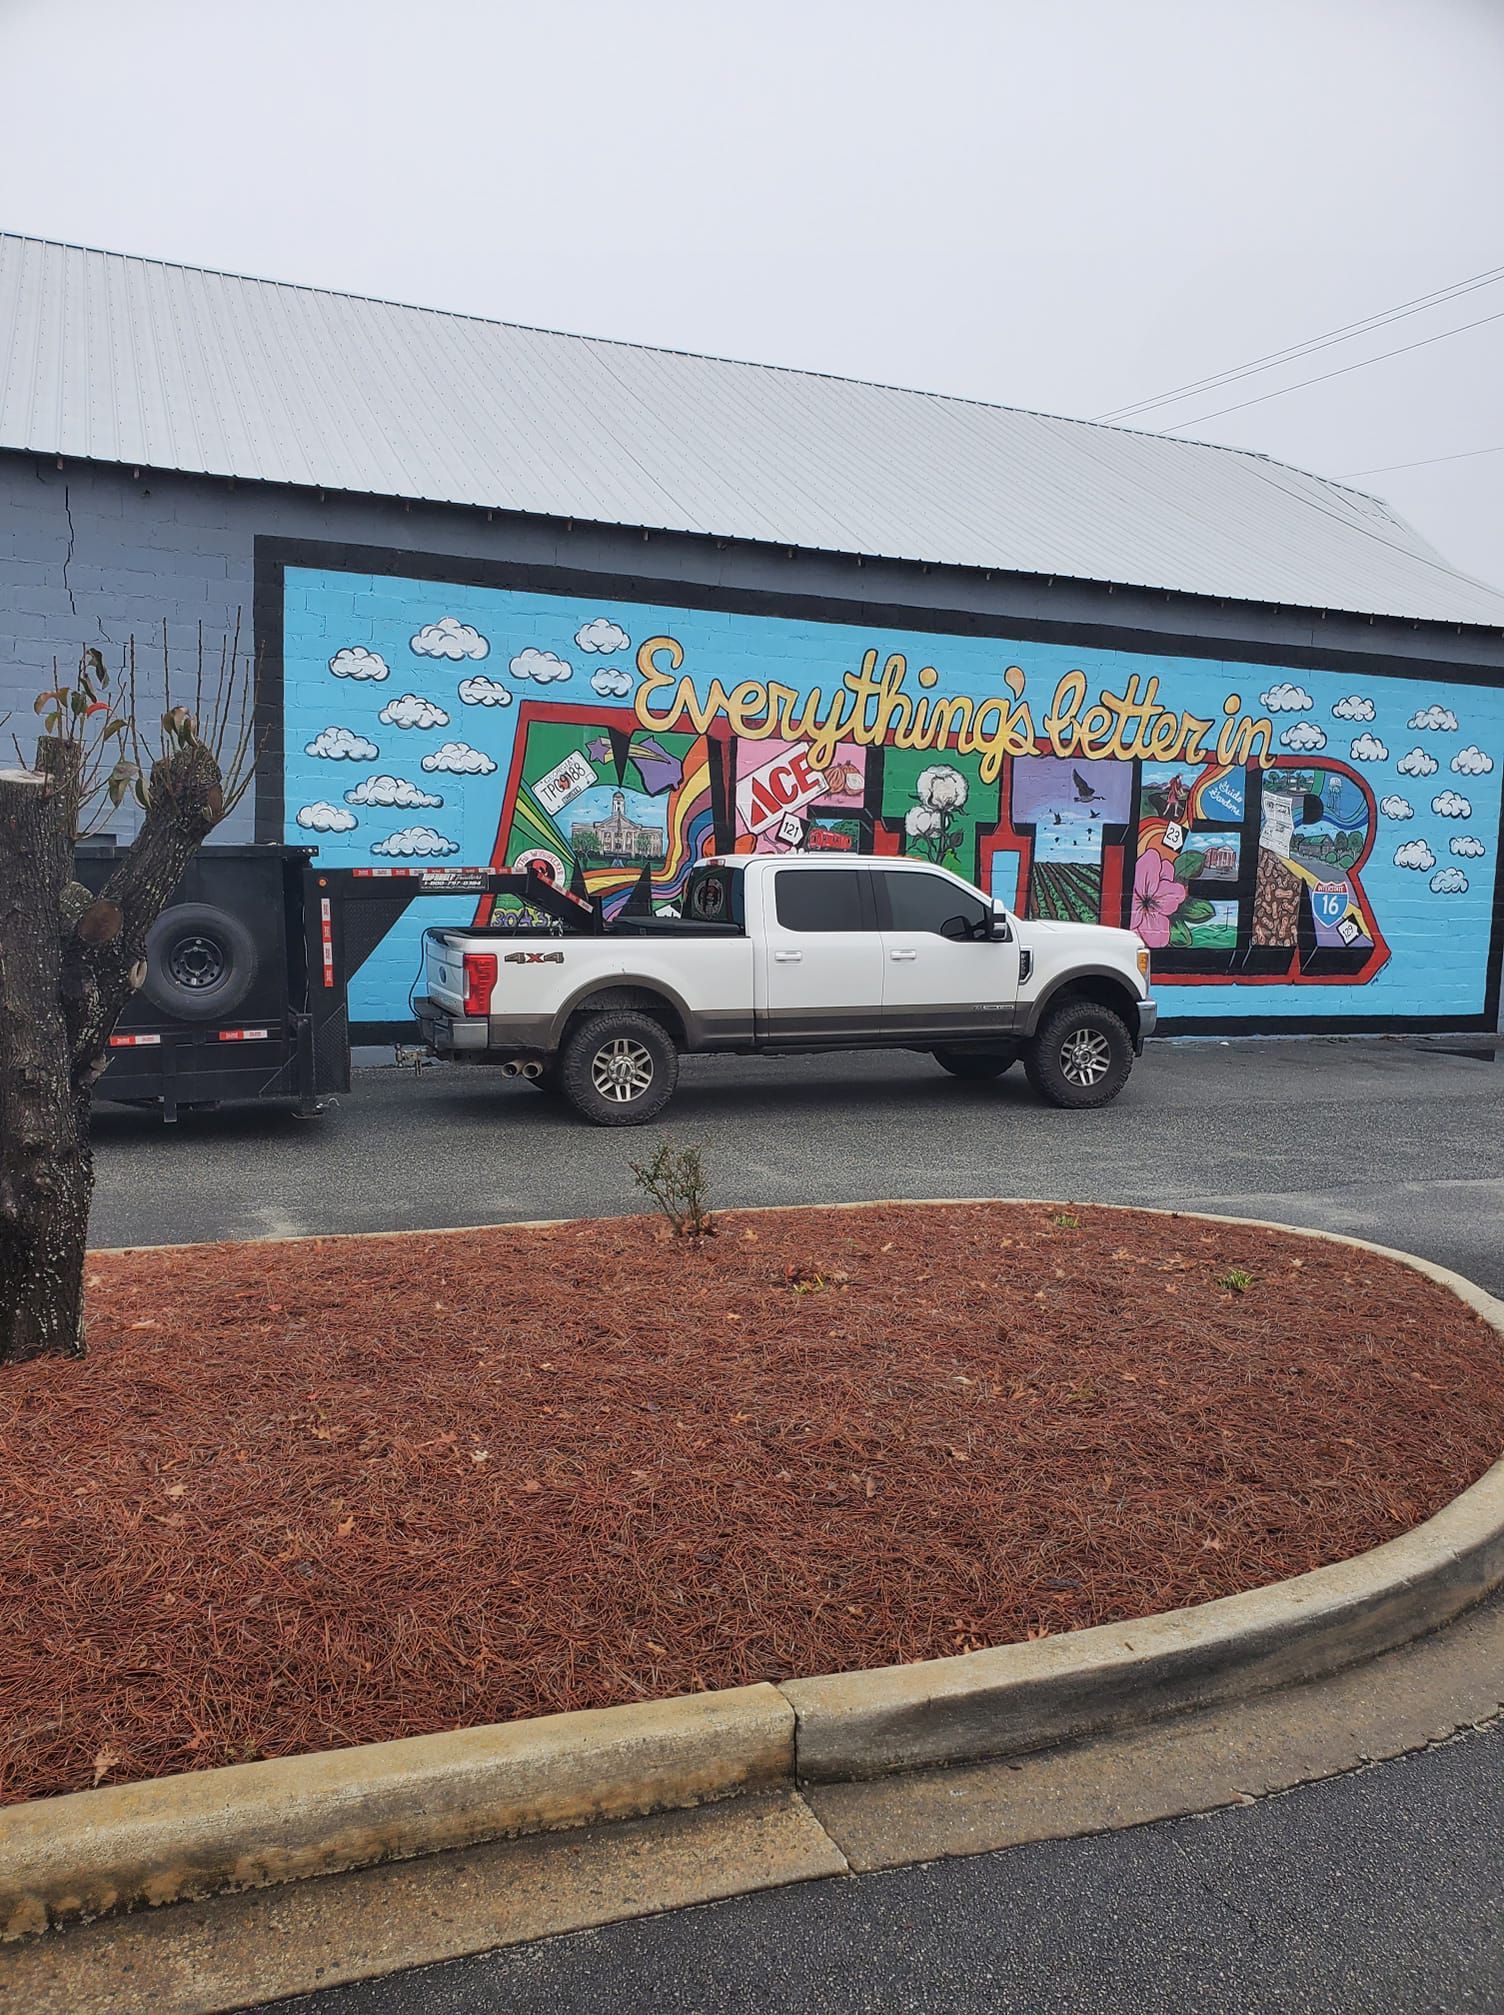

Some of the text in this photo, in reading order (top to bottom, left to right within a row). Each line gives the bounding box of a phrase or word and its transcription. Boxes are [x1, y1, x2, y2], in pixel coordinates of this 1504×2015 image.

[635, 635, 1277, 785] Everything's better in
[751, 751, 820, 828] ACE
[784, 821, 799, 838] 121
[1166, 827, 1180, 843] 23
[1322, 895, 1339, 915] 16
[1343, 924, 1354, 938] 129
